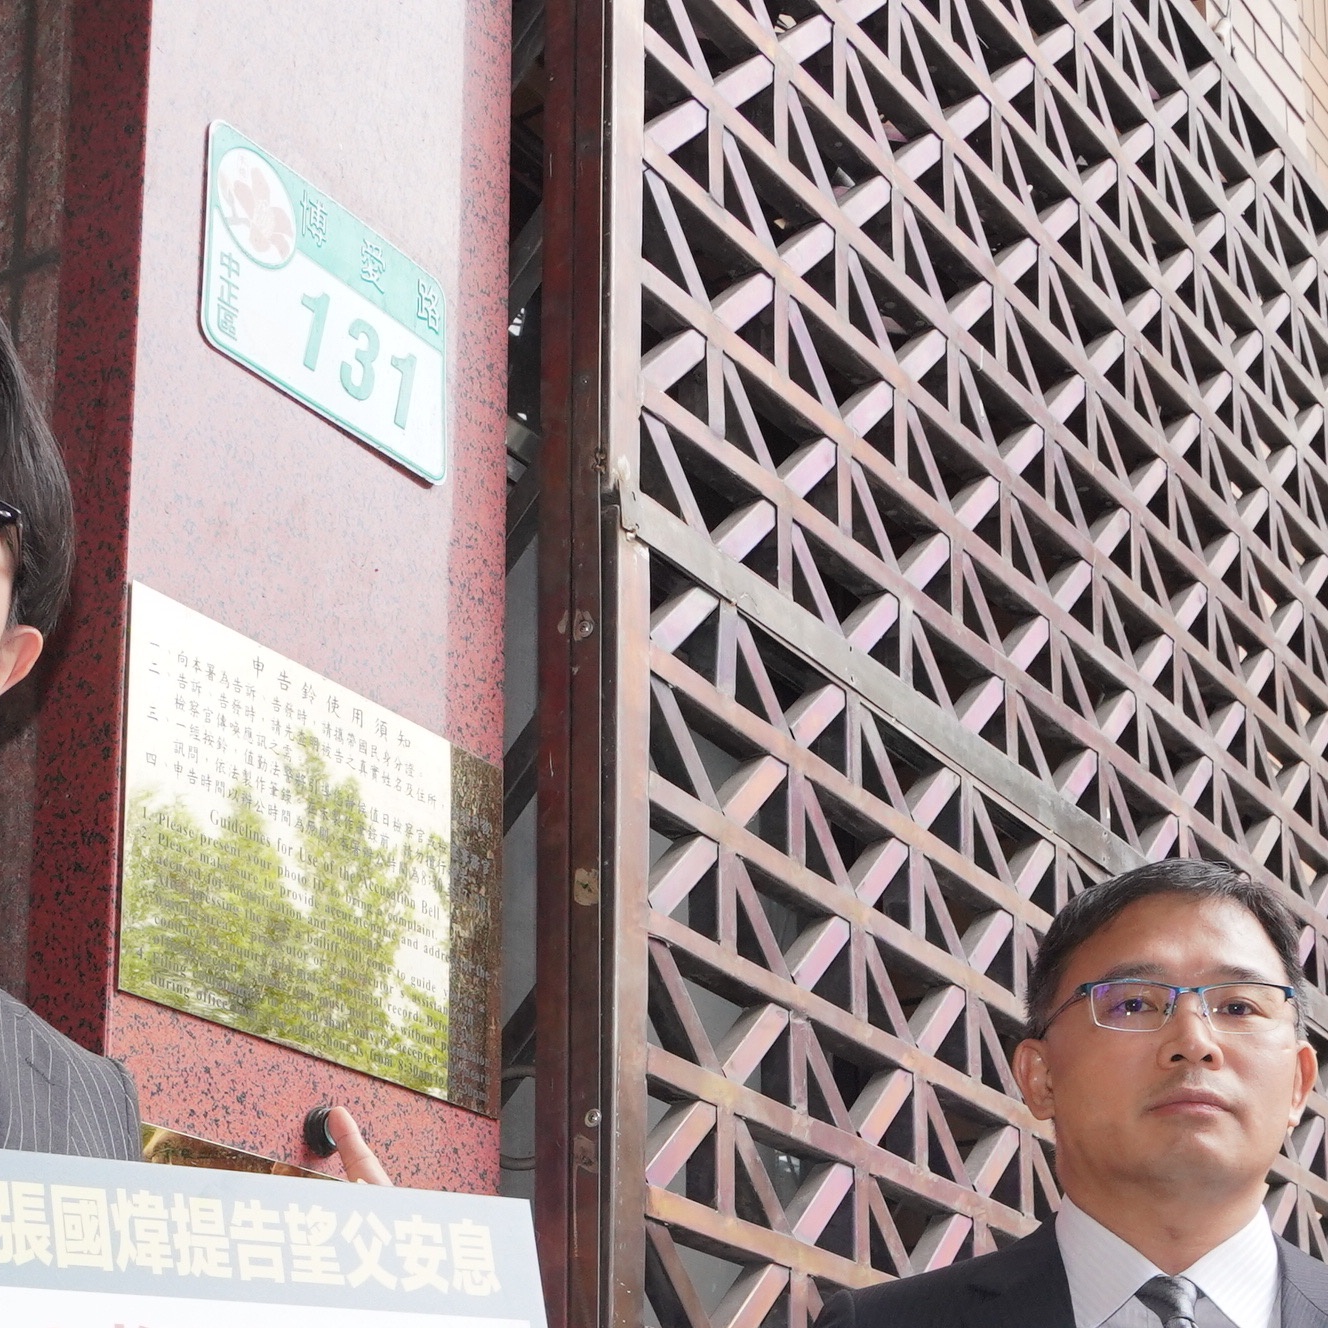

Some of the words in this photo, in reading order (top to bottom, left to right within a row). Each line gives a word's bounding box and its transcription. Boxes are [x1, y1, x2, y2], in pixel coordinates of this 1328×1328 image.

[217, 252, 241, 341] 中正區
[299, 189, 440, 335] 博愛路
[301, 291, 418, 431] 131
[251, 652, 411, 753] 申告鈴使用須知
[140, 824, 151, 841] 2.
[157, 831, 194, 859] Please
[199, 849, 230, 873] make
[235, 866, 259, 885] sure
[263, 876, 274, 891] to
[278, 881, 319, 913] provide
[324, 902, 368, 929] accurate
[369, 921, 396, 941] name
[400, 932, 418, 950] and
[141, 805, 151, 821] 1.
[157, 811, 195, 840] Please
[199, 831, 240, 861] present
[247, 852, 272, 875] your
[276, 861, 307, 888] photo
[312, 876, 325, 893] ID
[330, 885, 340, 900] to
[345, 890, 372, 916] bring
[376, 907, 383, 917] a
[387, 908, 438, 944] complaint.
[156, 851, 201, 882] accused
[206, 872, 223, 890] for
[307, 912, 326, 931] and
[209, 807, 271, 849] Guidelines
[276, 836, 292, 858] for
[298, 846, 318, 869] Use
[323, 856, 335, 876] of
[338, 863, 356, 884] the
[361, 873, 416, 910] Accusation
[421, 898, 440, 921] Bell
[136, 945, 147, 962] 4.
[151, 950, 186, 978] Filing
[324, 1014, 348, 1033] shall
[379, 1034, 390, 1049] be
[396, 1040, 437, 1069] accepted
[296, 966, 324, 987] make
[346, 985, 383, 1009] official
[387, 1000, 422, 1025] record.
[306, 929, 340, 954] bailiff
[344, 944, 362, 963] will
[366, 955, 392, 975] come
[396, 966, 406, 981] to
[410, 971, 436, 996] guide
[312, 955, 323, 968] or
[340, 965, 394, 997] prosecutor
[150, 971, 190, 1000] during
[195, 986, 229, 1011] office
[368, 1049, 393, 1069] from
[435, 1072, 445, 1087] to
[319, 993, 345, 1013] must
[370, 1013, 395, 1032] leave
[399, 1023, 436, 1047] without
